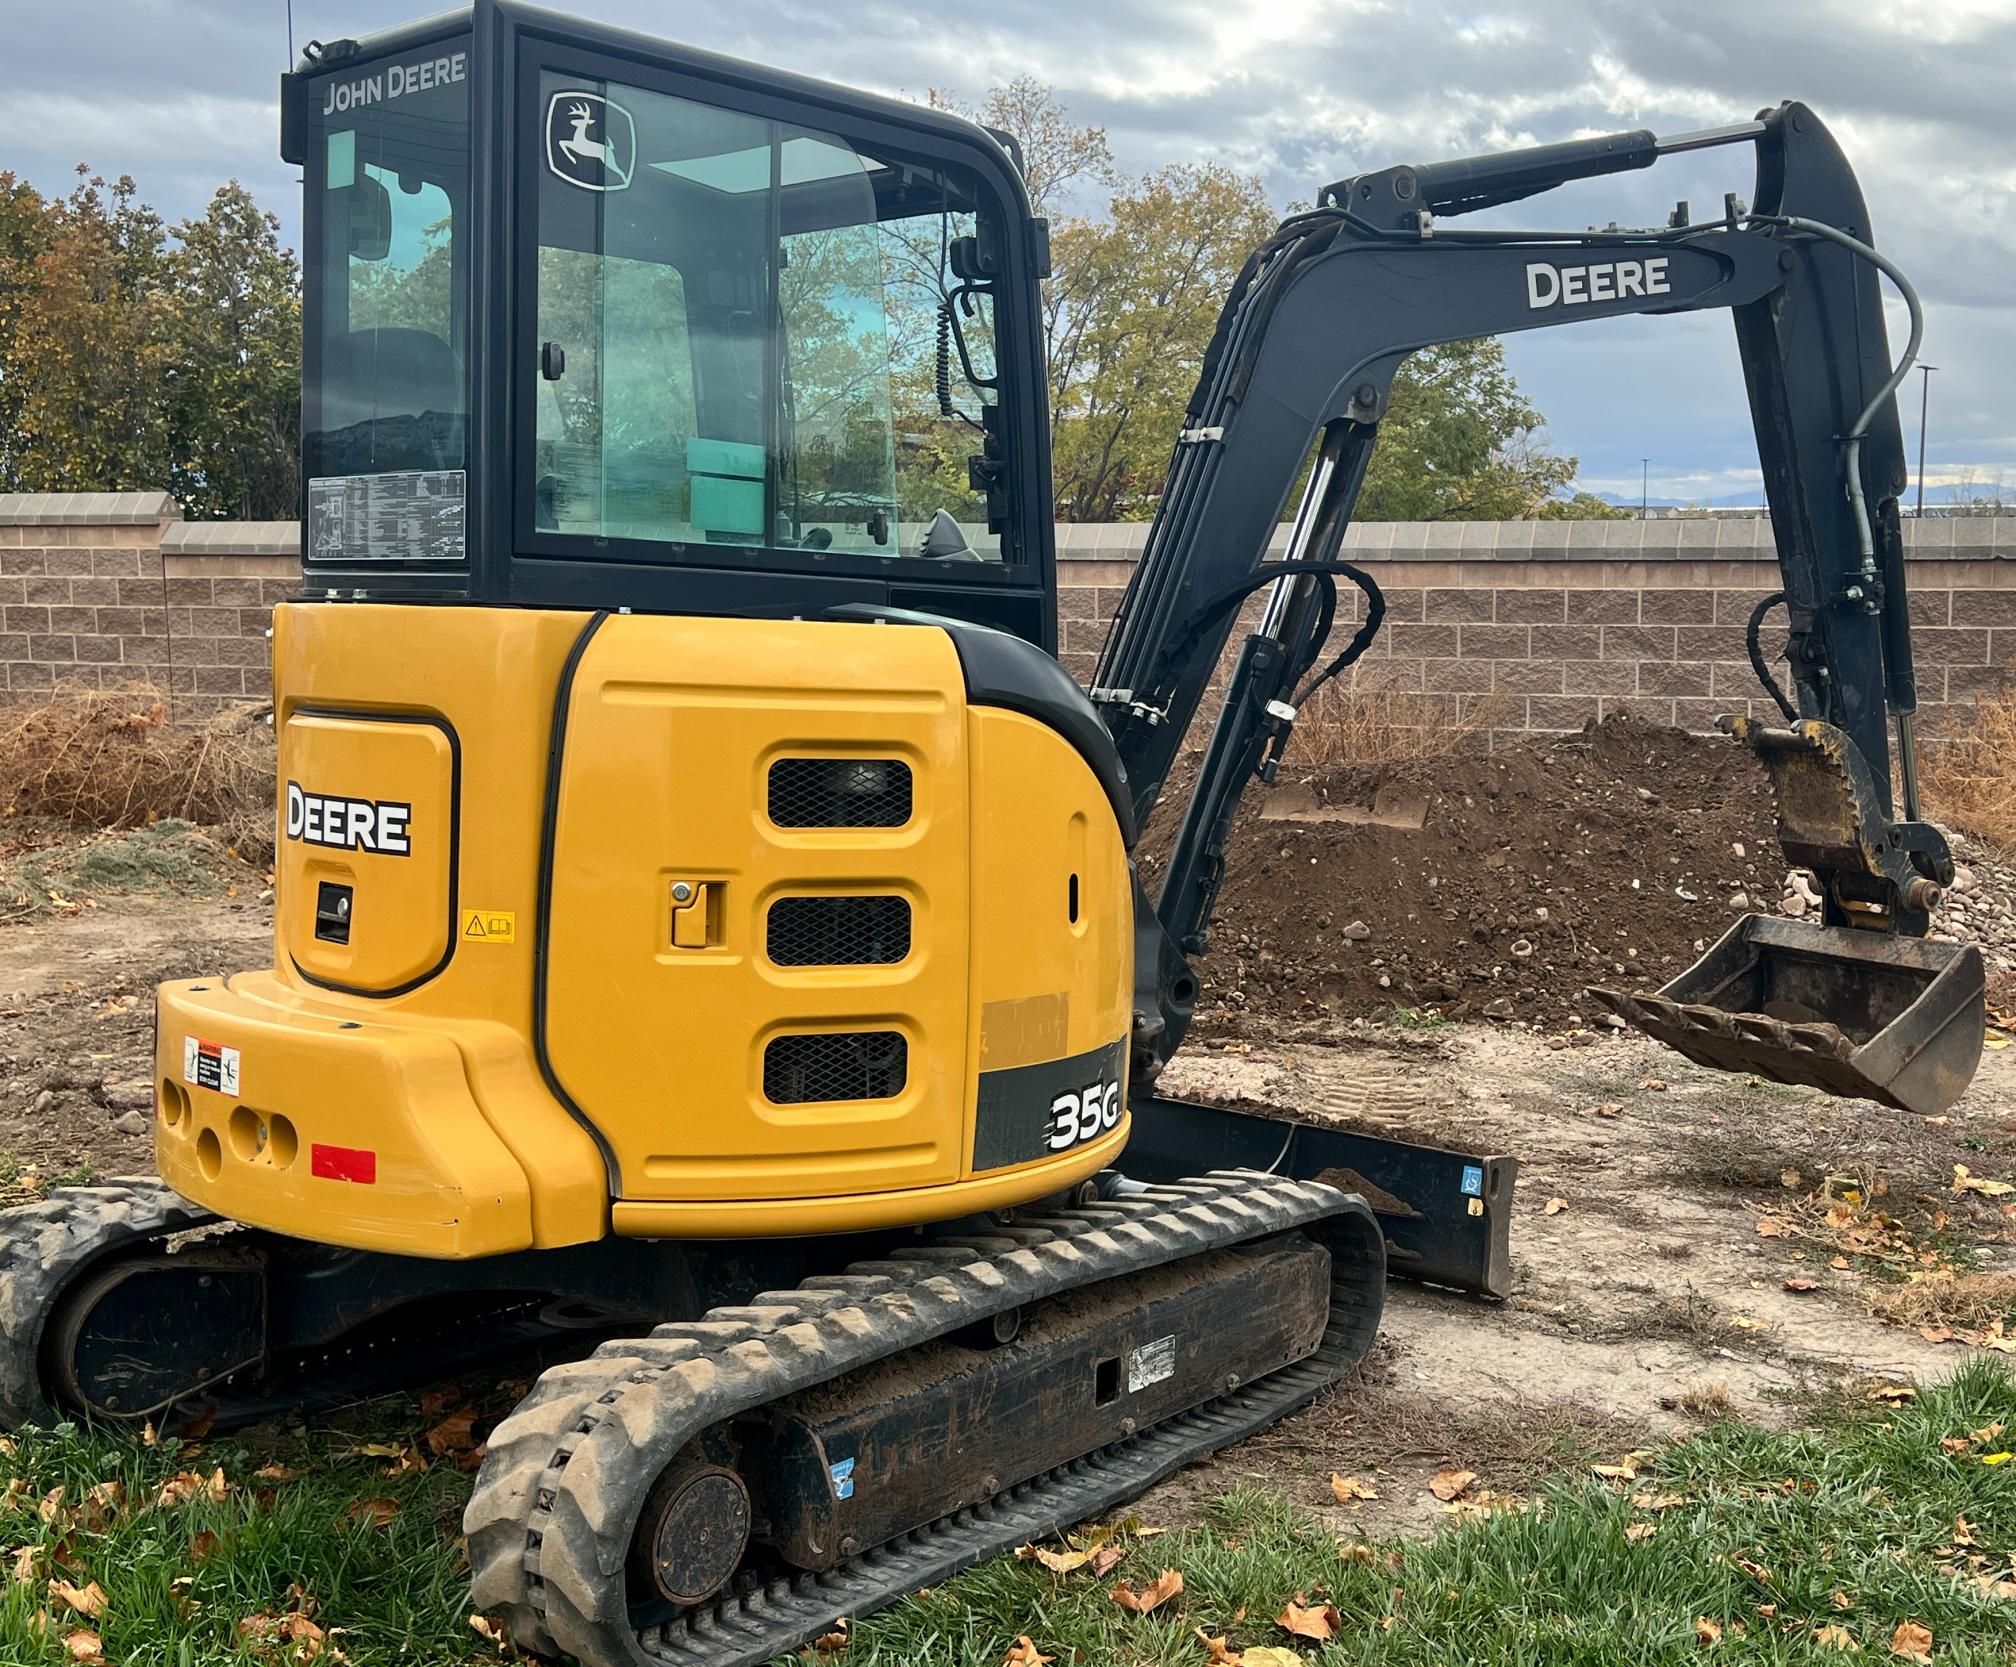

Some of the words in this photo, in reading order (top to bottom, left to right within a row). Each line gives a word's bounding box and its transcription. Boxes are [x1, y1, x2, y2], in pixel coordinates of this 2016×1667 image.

[323, 75, 382, 116] JOHN
[387, 51, 467, 99] DEERE
[1525, 256, 1672, 309] DEERE
[287, 783, 409, 853] DEERE
[1048, 1080, 1119, 1150] 35G
